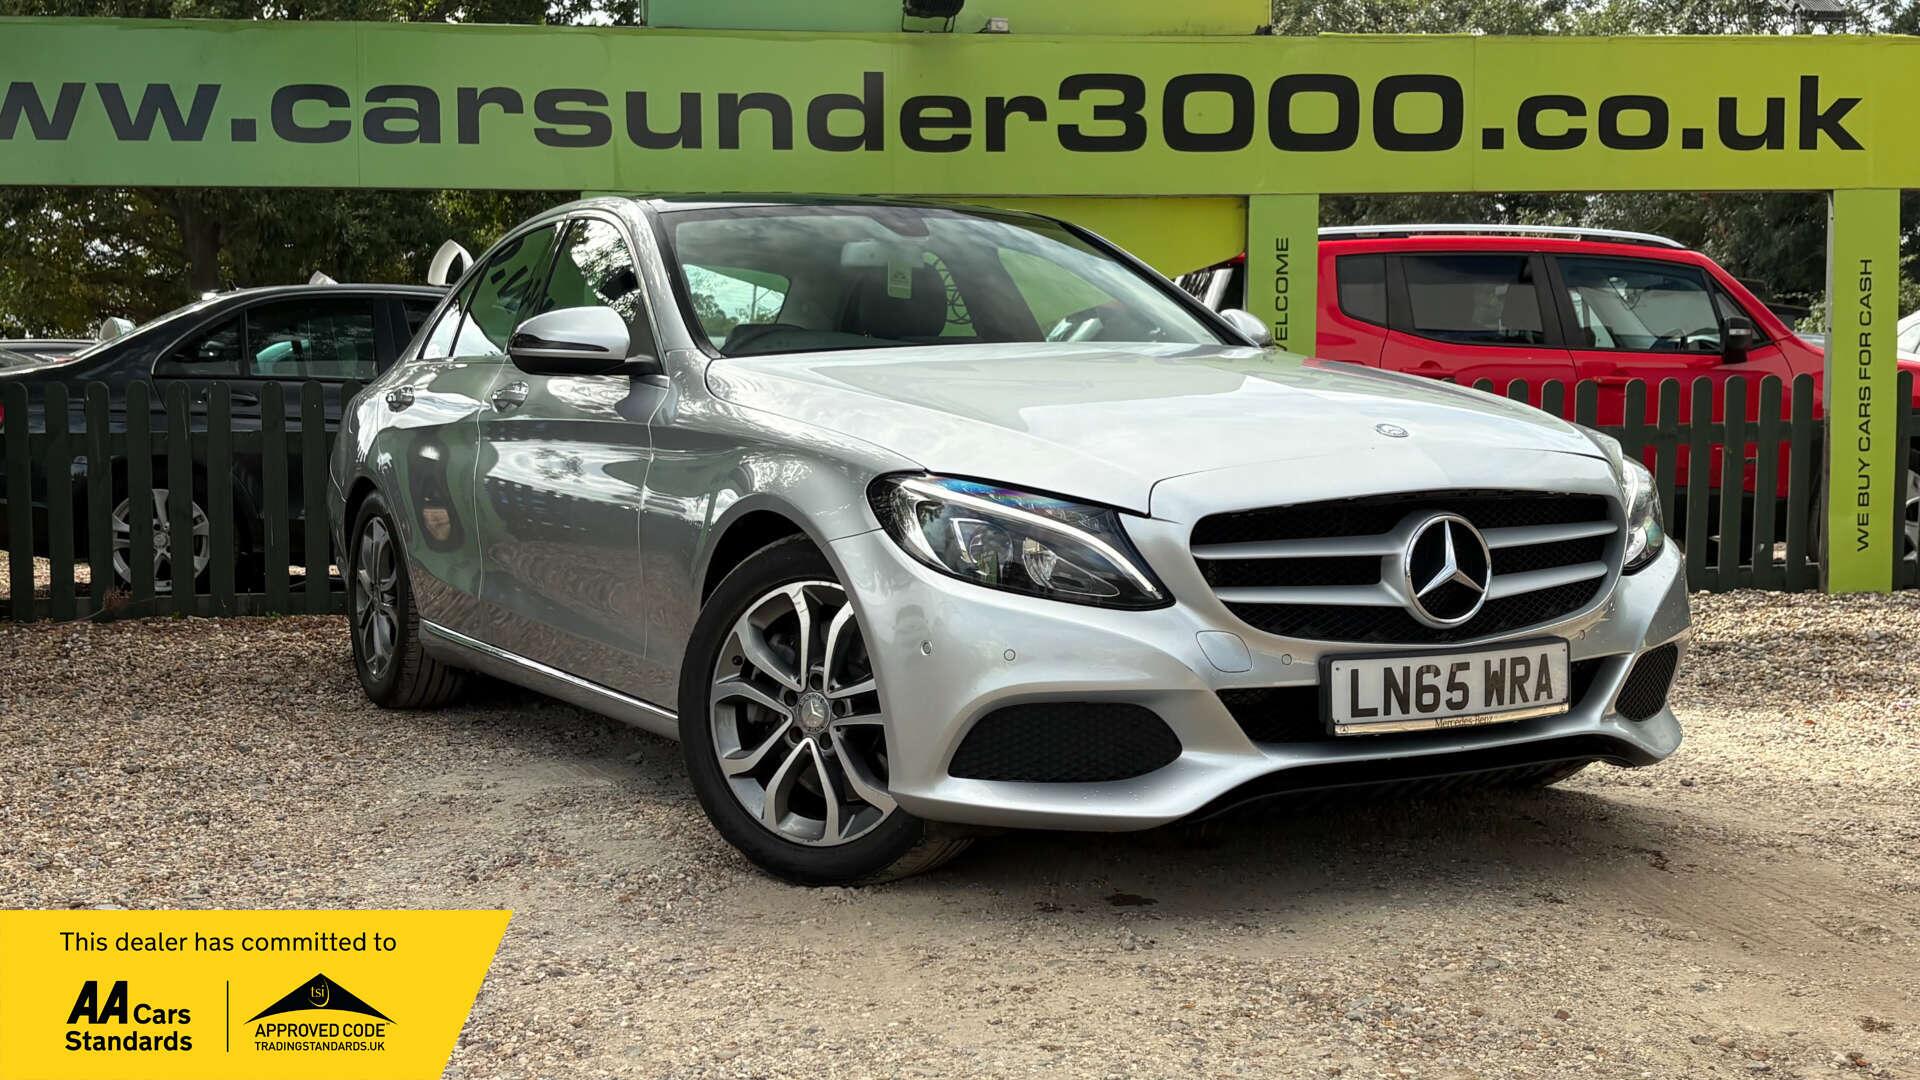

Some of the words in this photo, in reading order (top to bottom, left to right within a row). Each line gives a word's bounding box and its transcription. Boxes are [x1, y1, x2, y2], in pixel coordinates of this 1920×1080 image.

[0, 71, 1865, 153] ww.carsunder3000.co.uk
[1859, 259, 1873, 326] CASH
[1858, 332, 1872, 380] FOR
[1858, 385, 1872, 452] CARS
[1857, 457, 1871, 507] BUY
[1856, 512, 1870, 553] WE
[1350, 661, 1470, 718] LN65
[1484, 652, 1554, 708] WRA
